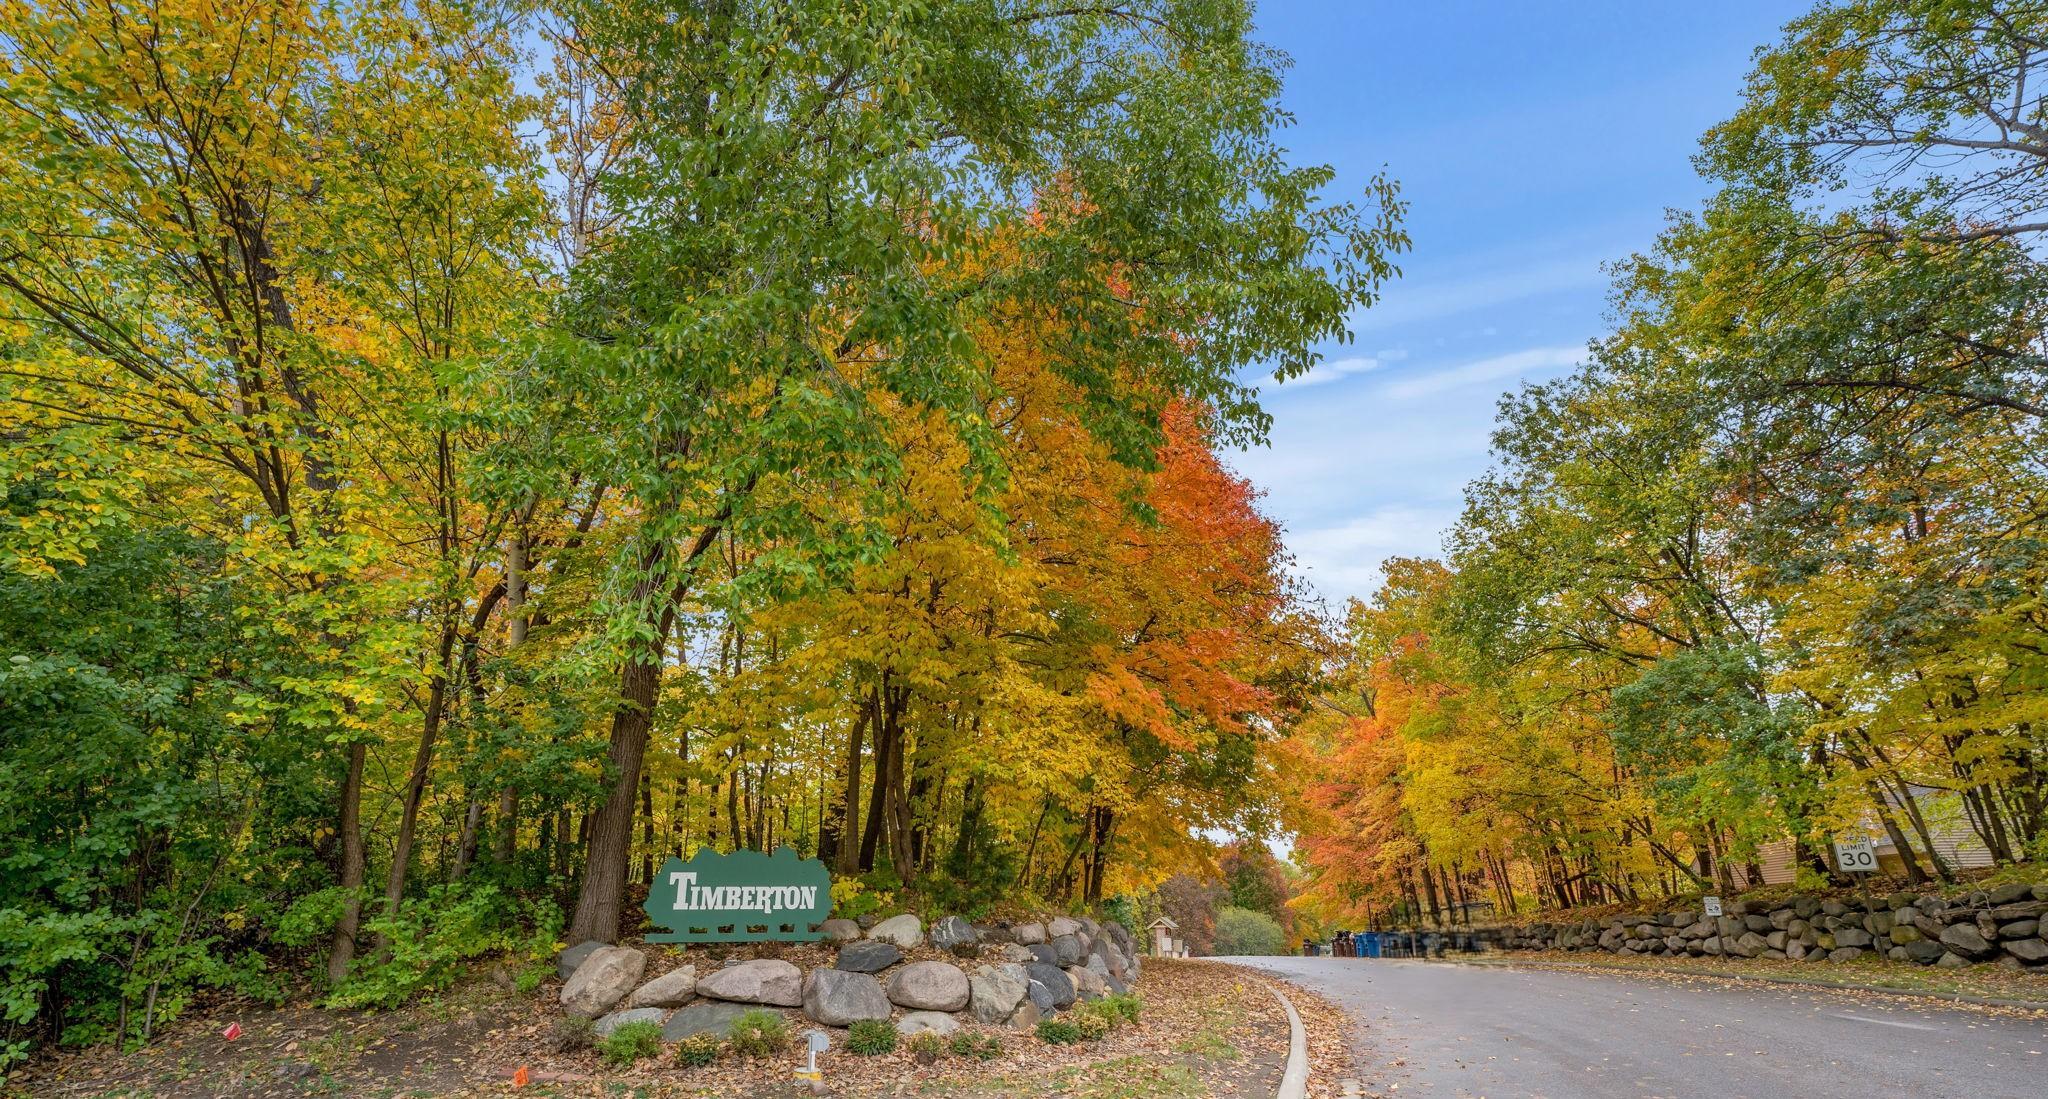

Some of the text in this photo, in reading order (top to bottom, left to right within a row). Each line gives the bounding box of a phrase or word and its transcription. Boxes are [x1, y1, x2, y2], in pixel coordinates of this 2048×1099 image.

[1841, 843, 1866, 851] LIMIT
[1841, 852, 1872, 866] 30
[669, 872, 817, 913] TIMBERTON
